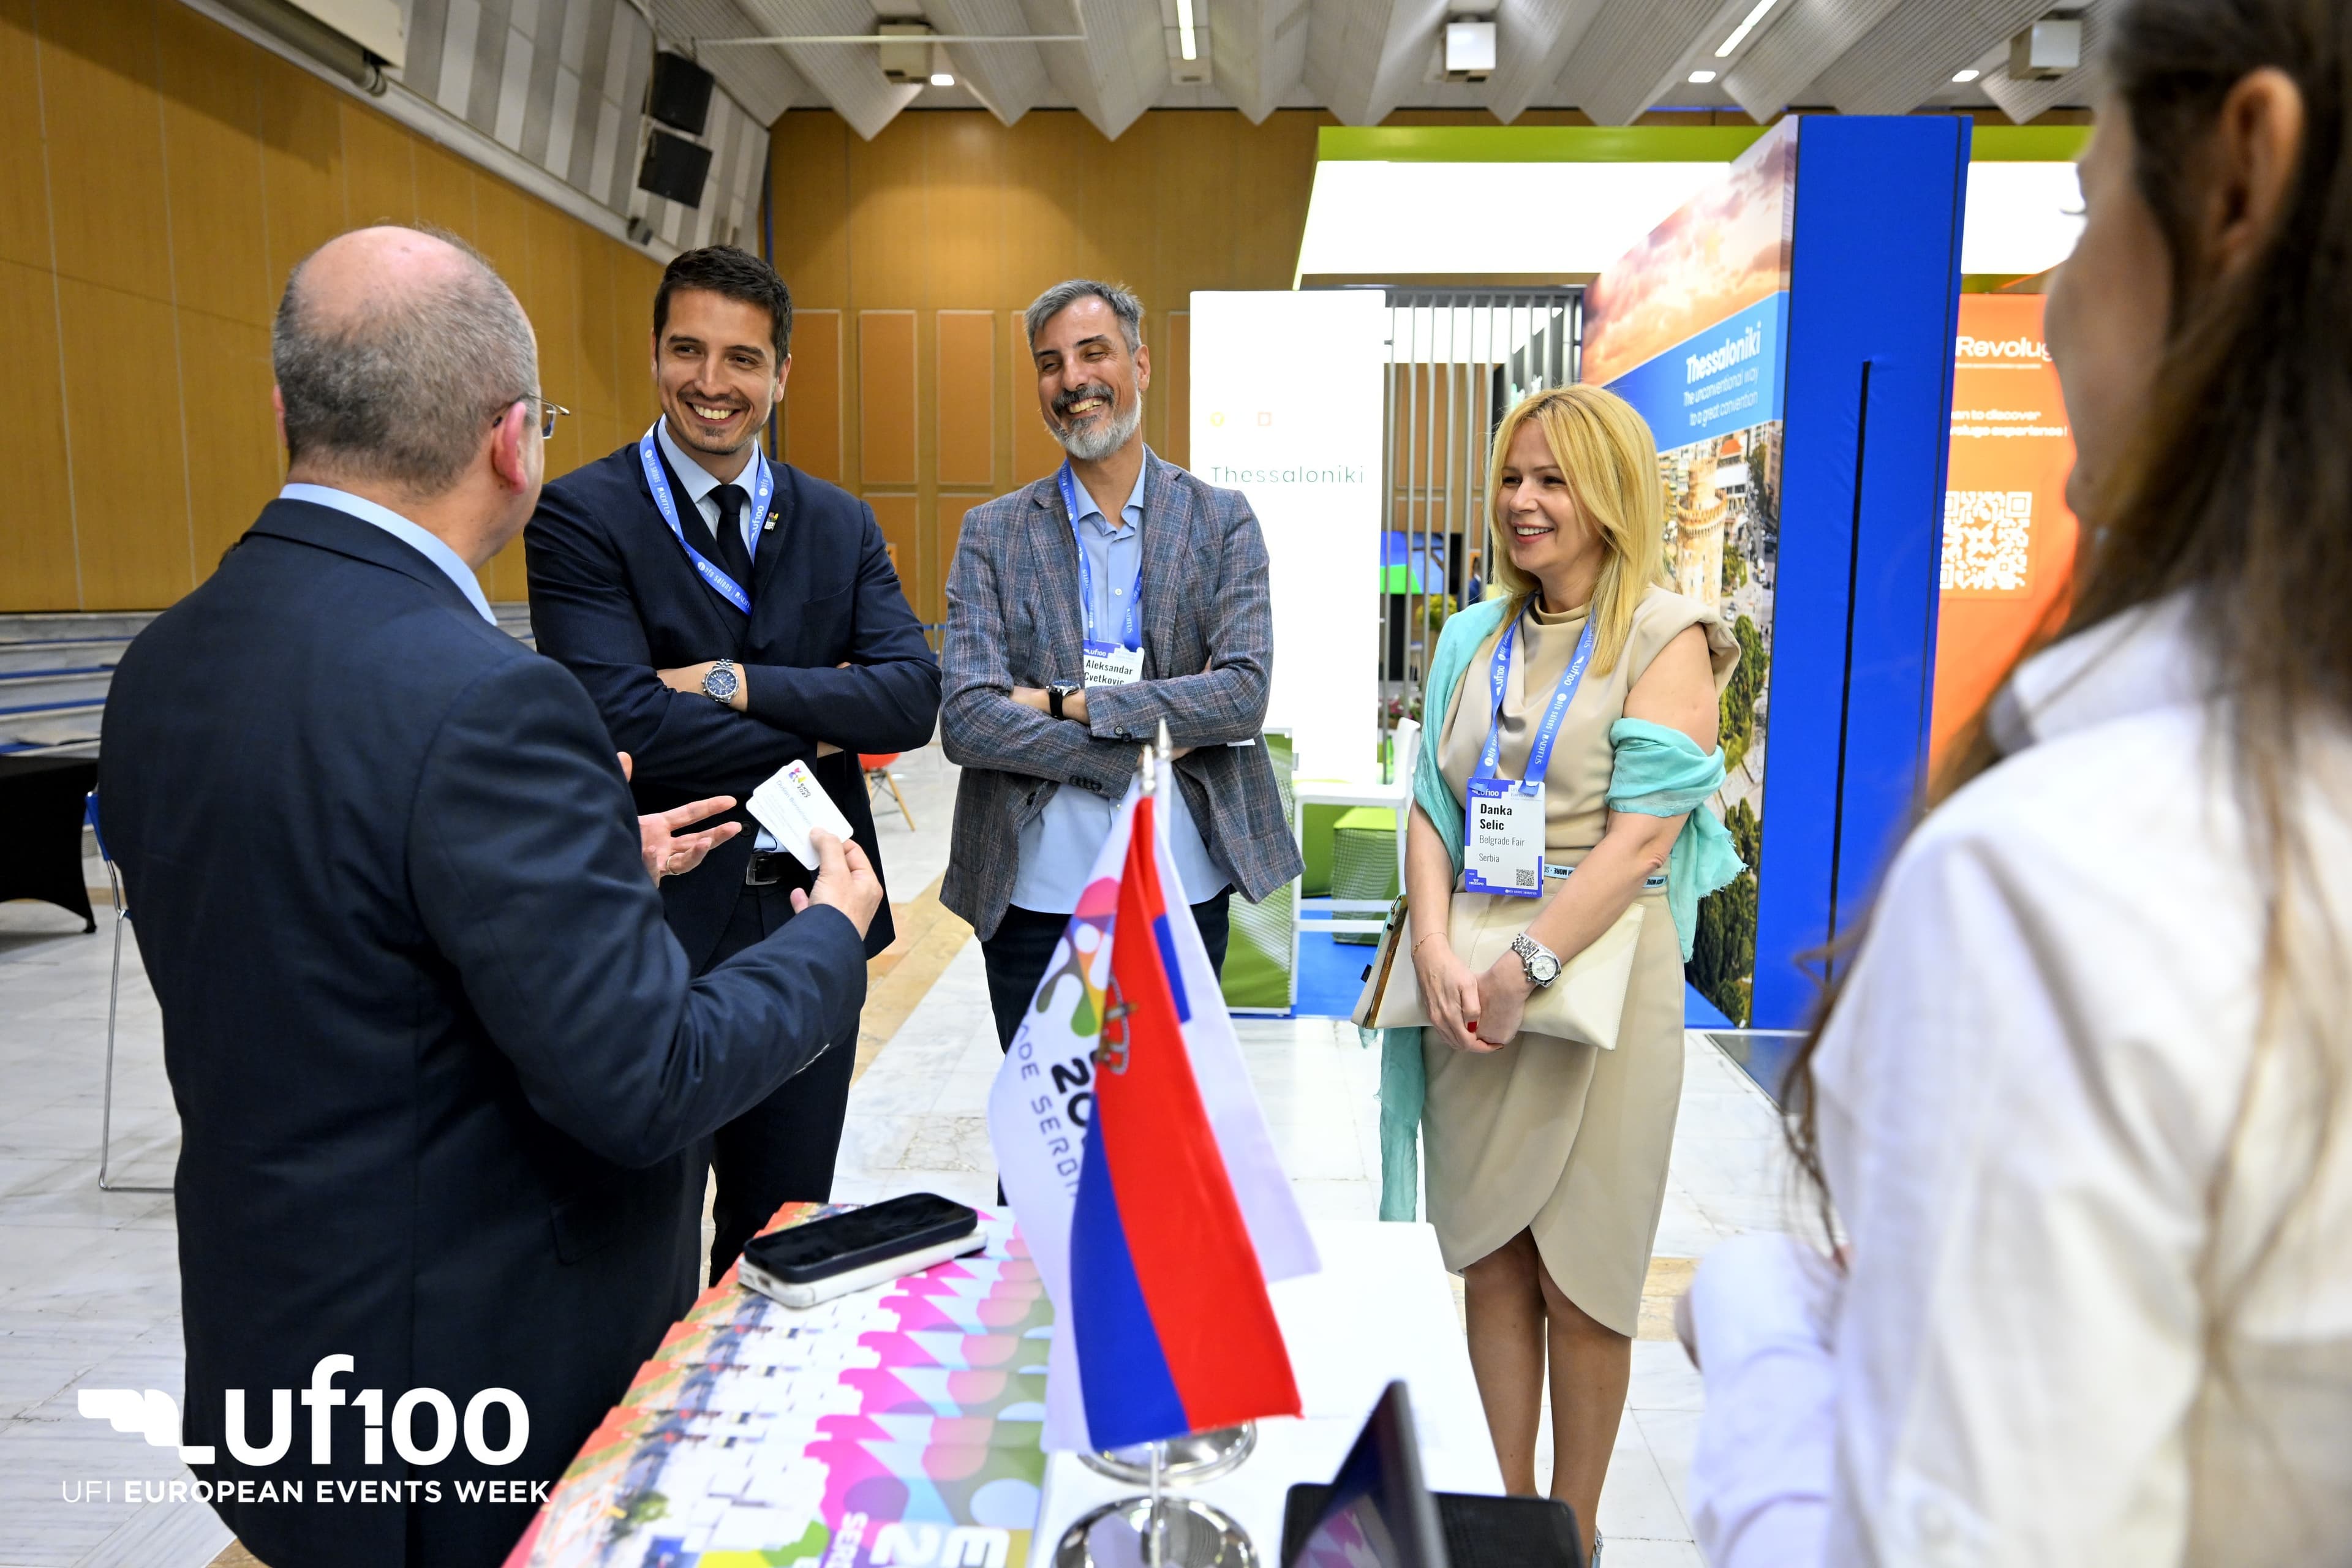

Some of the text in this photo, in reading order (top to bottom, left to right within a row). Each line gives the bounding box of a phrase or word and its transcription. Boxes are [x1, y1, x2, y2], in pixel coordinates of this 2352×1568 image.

[1686, 320, 1762, 385] Thessaloniki
[1683, 366, 1759, 407] The unconventional way
[1689, 412, 1697, 426] to
[1702, 404, 1719, 428] great
[1720, 391, 1758, 416] convention
[1986, 409, 2041, 420] discover
[1211, 466, 1364, 483] Thessaloniki
[1085, 660, 1133, 675] Aleksandar
[1480, 804, 1512, 816] Danka
[1480, 819, 1504, 831] Selic
[1479, 835, 1525, 846] Belgrade Fair
[1479, 853, 1499, 862] Serbia
